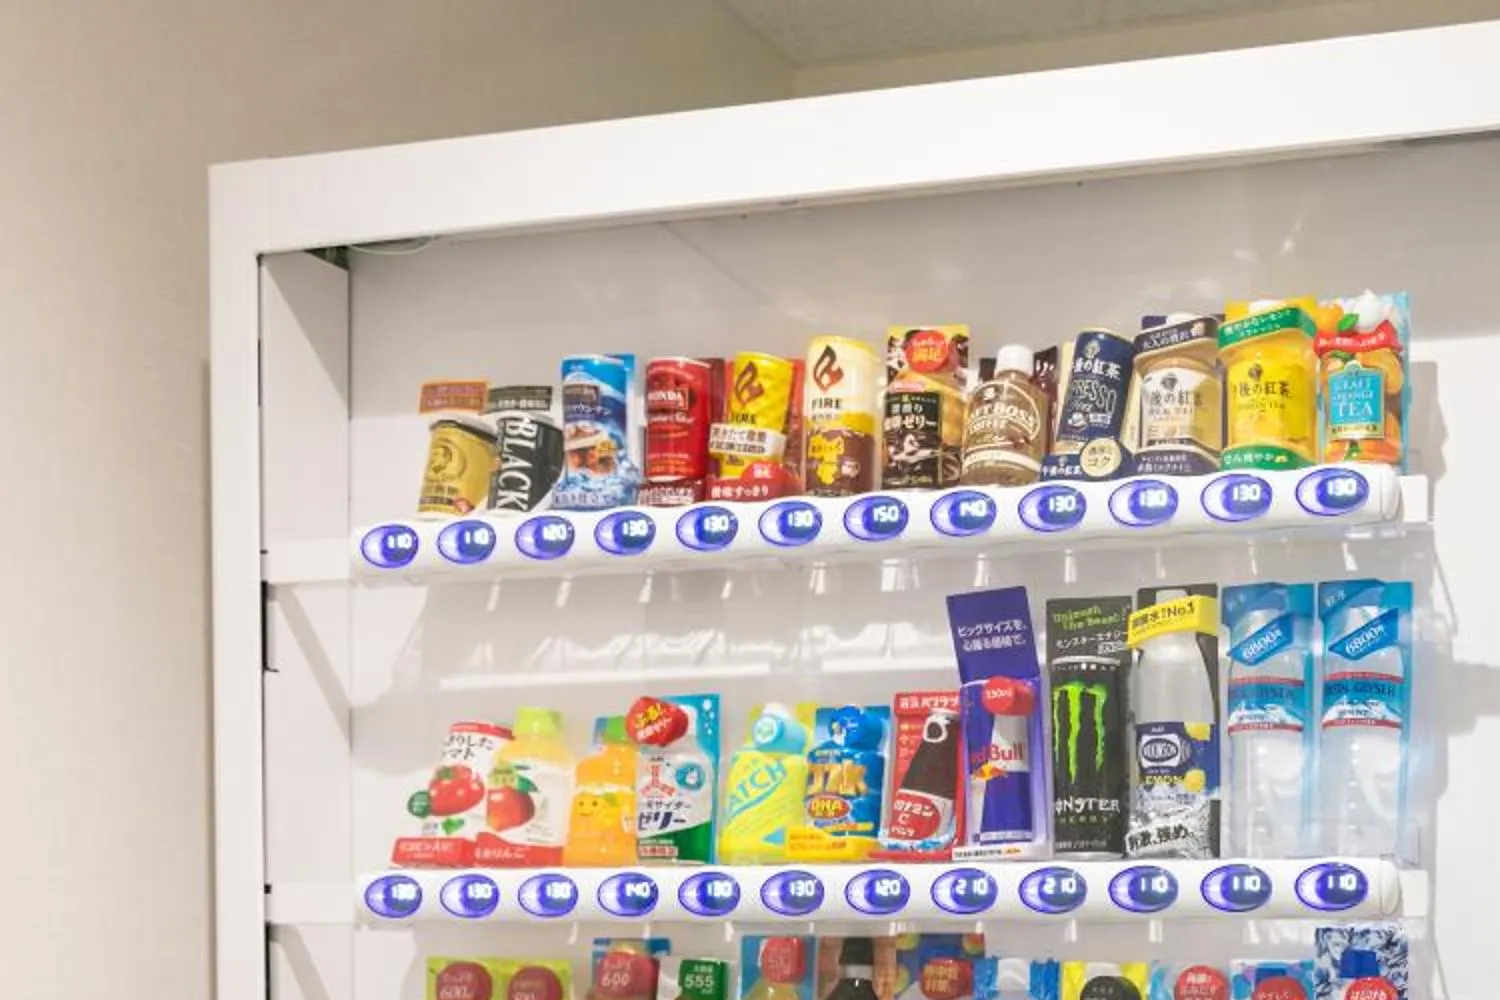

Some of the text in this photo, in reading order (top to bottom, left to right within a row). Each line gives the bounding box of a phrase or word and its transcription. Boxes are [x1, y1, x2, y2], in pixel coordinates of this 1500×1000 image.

[1072, 358, 1121, 380] 後の紅茶
[811, 398, 844, 410] FIRE
[1338, 404, 1373, 417] TEA
[496, 414, 539, 512] BLACK
[623, 519, 649, 537] 130
[787, 509, 814, 528] 130
[873, 505, 900, 523] 150
[1049, 494, 1077, 513] 130
[1232, 483, 1262, 502] 130
[1327, 477, 1357, 497] 130
[992, 742, 1024, 761] Bull
[1144, 775, 1184, 786] EMON
[1055, 796, 1122, 816] ONSTER
[638, 811, 687, 830] ゼリー
[896, 813, 911, 825] C
[789, 879, 816, 897] 130
[955, 878, 989, 896] 210
[1043, 876, 1077, 895] 210
[1140, 874, 1169, 894] 110
[1233, 874, 1261, 892] 110
[1328, 873, 1357, 891] 110
[601, 971, 631, 988] 600
[683, 973, 714, 989] 555
